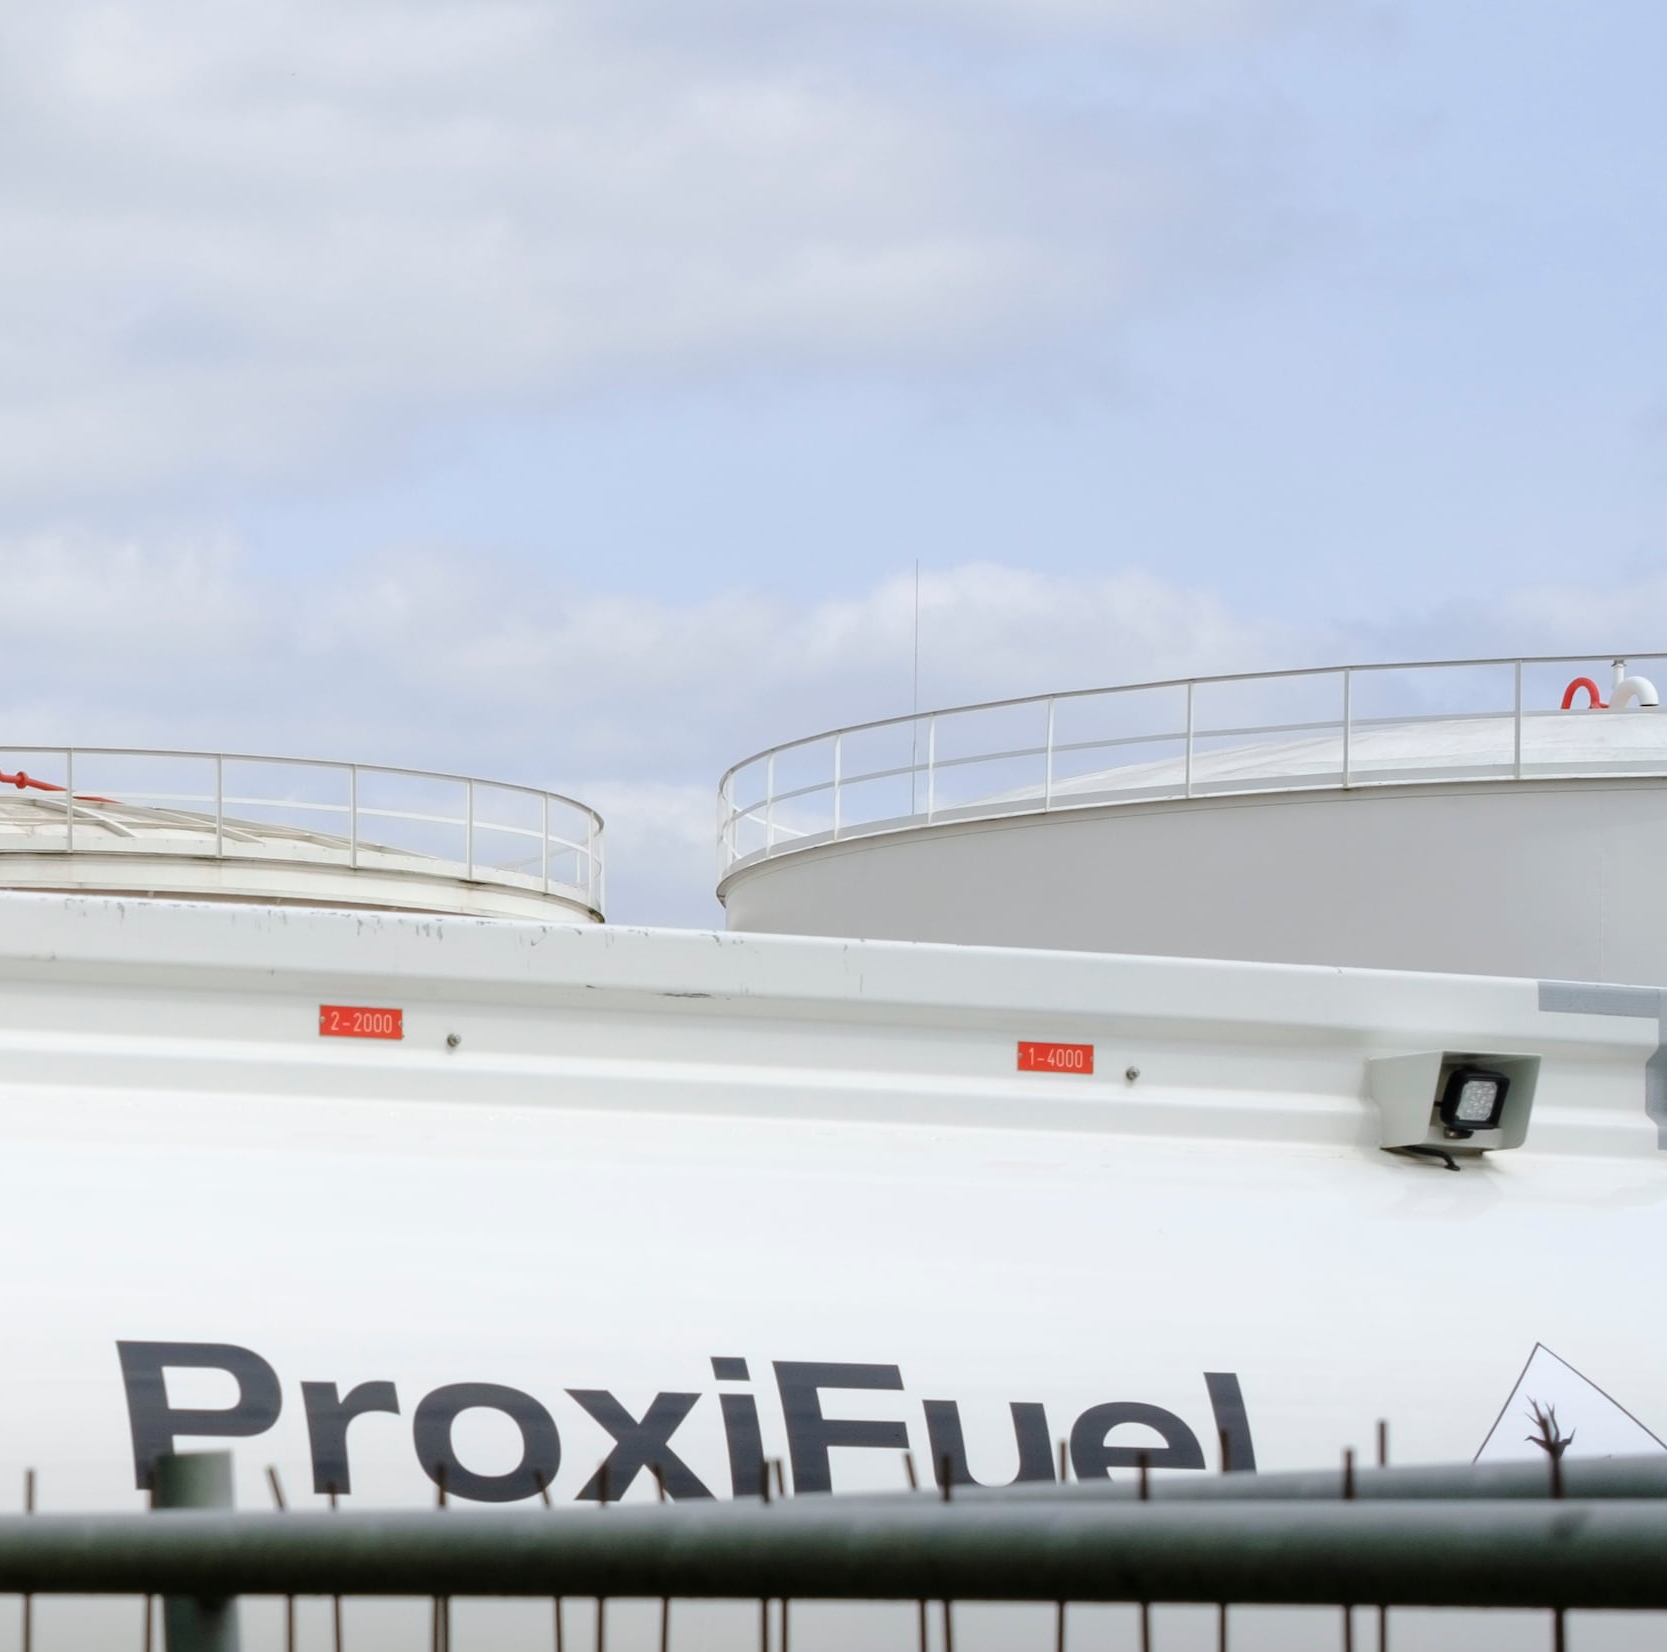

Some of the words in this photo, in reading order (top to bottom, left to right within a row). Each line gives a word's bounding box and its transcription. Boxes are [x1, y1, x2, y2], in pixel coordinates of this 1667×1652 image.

[330, 1011, 394, 1036] 2-2000
[1028, 1045, 1085, 1071] 1-4000
[114, 1340, 1255, 1502] ProxiFuel
